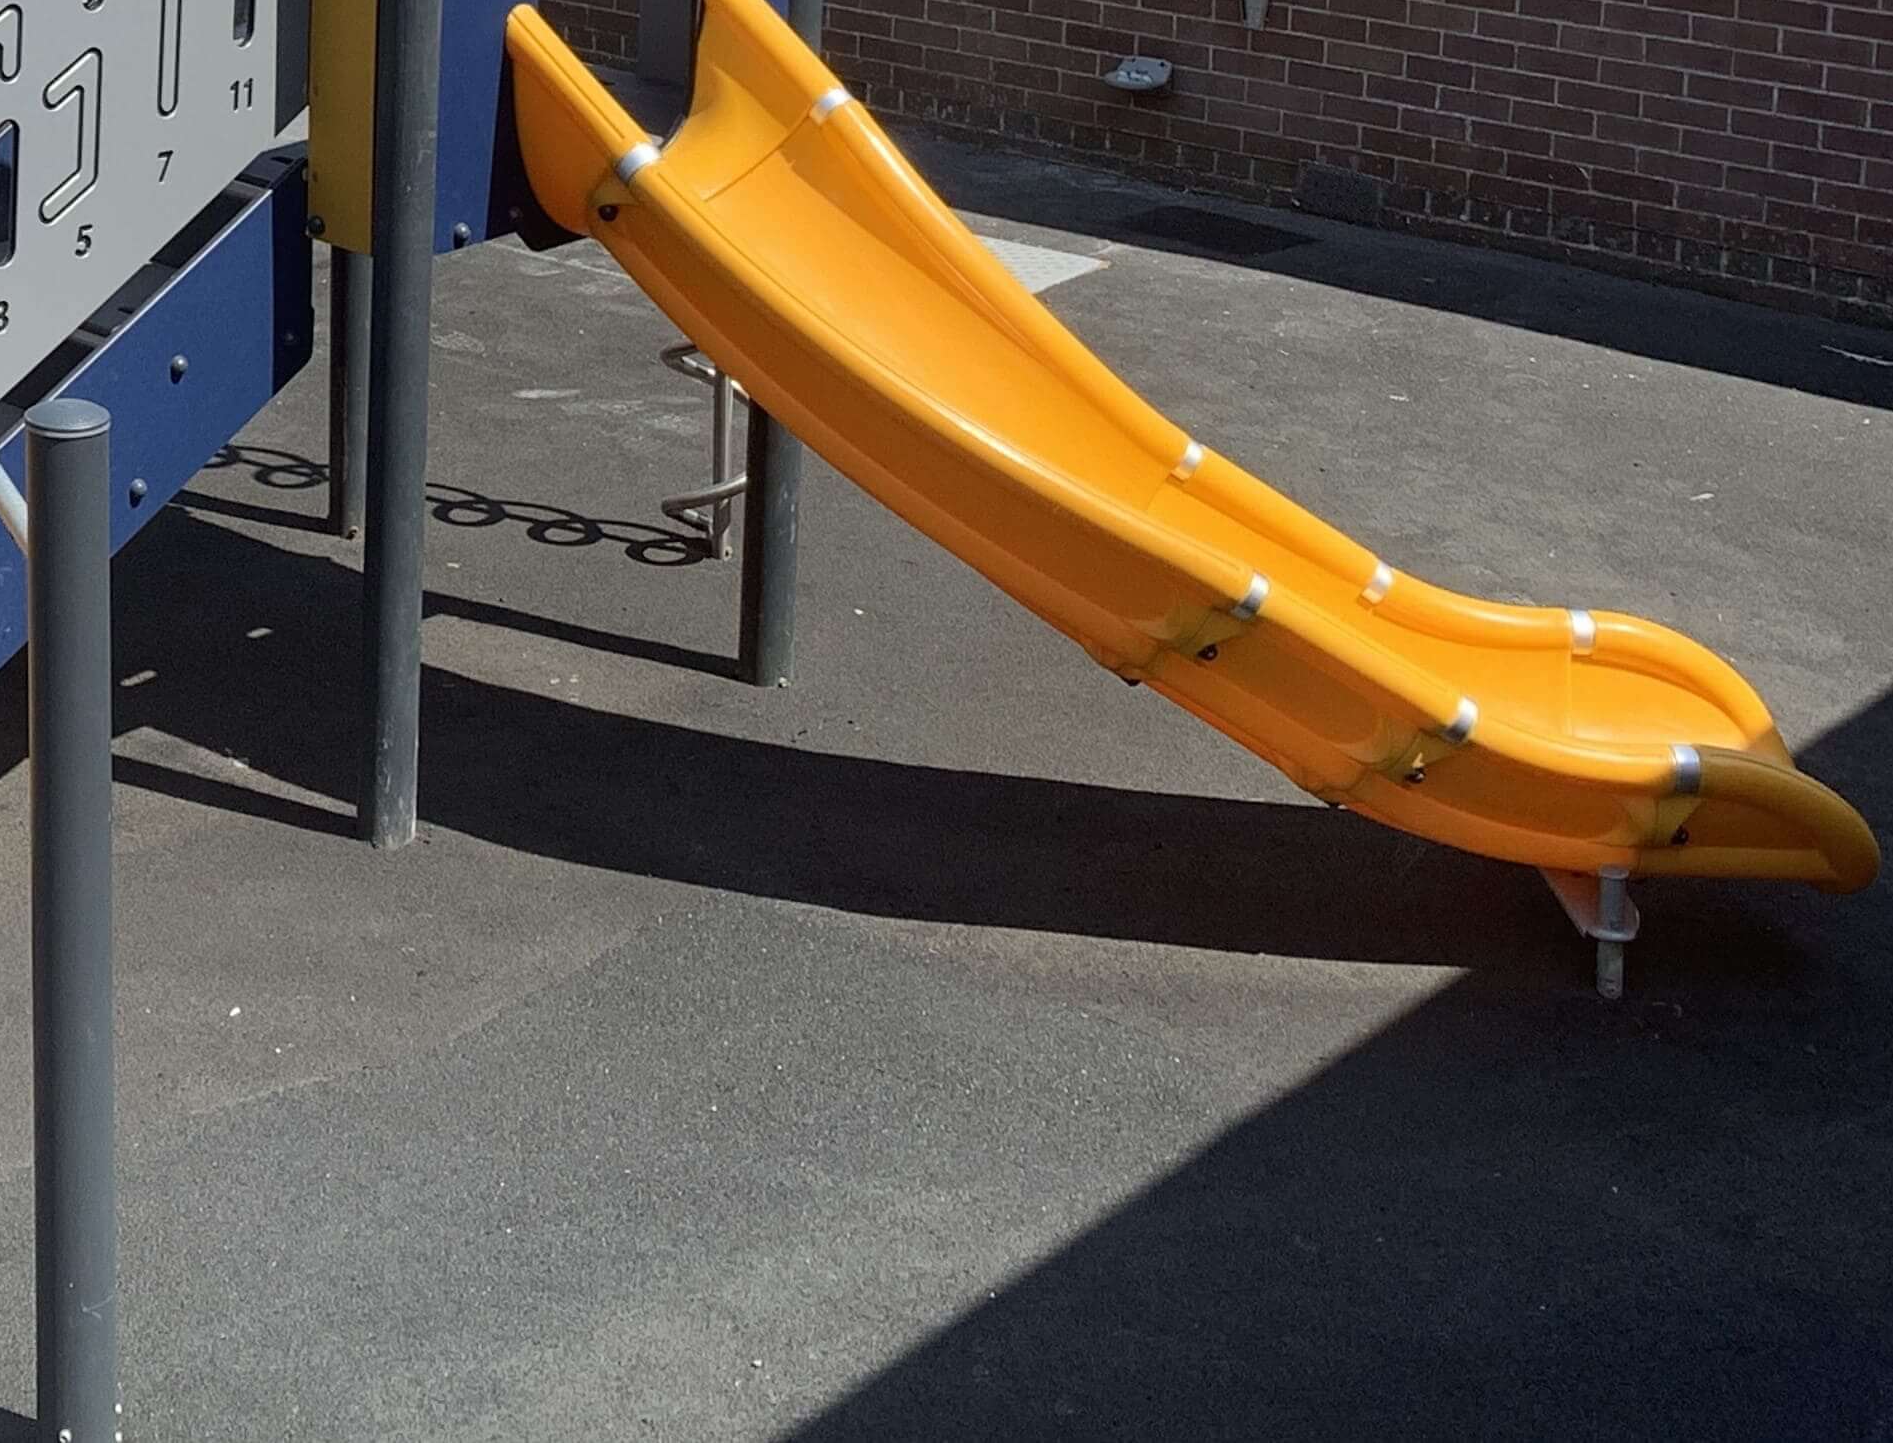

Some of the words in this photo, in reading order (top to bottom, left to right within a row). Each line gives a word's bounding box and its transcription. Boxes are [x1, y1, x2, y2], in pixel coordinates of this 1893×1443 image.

[230, 78, 253, 111] 11
[158, 150, 174, 183] 7
[75, 224, 93, 257] 5
